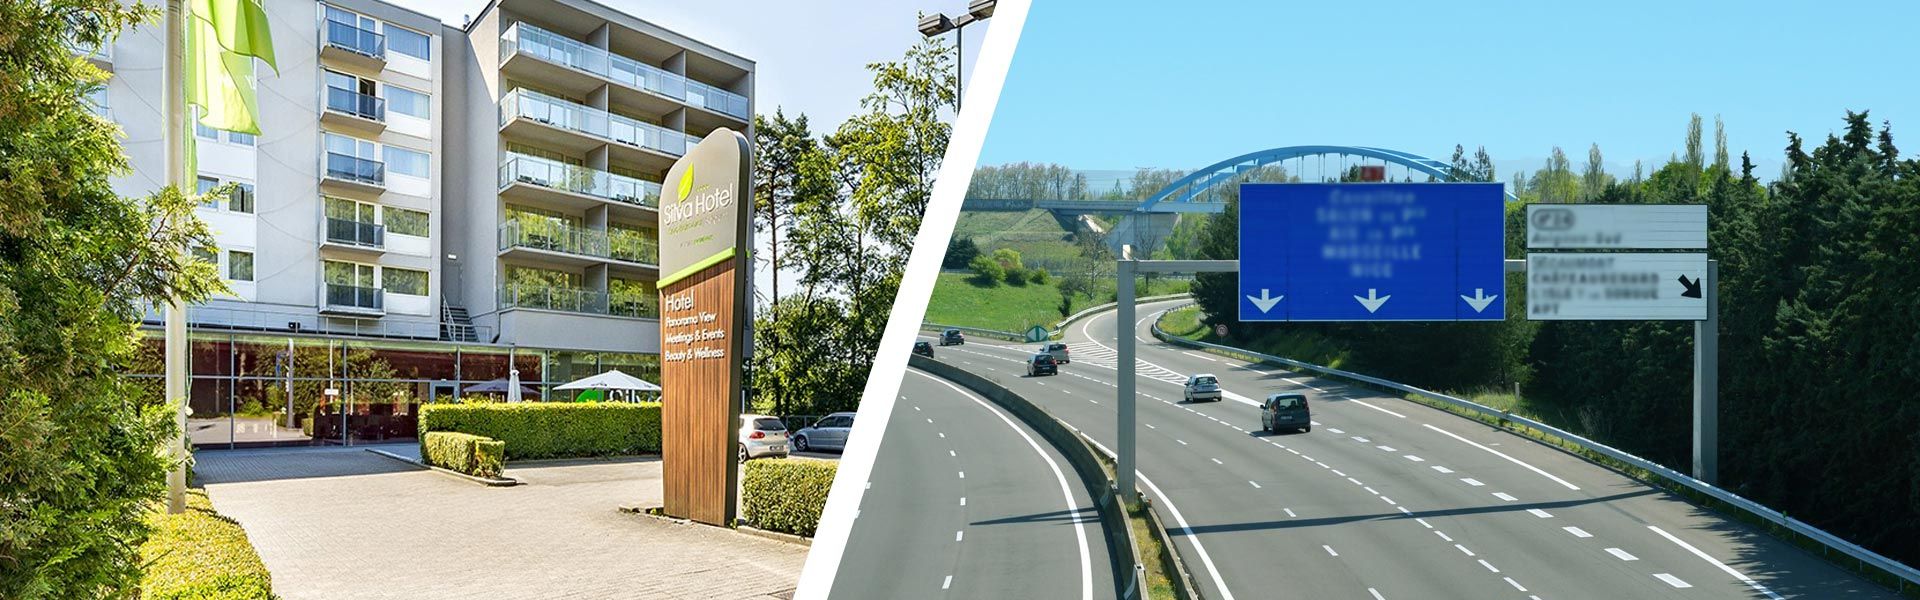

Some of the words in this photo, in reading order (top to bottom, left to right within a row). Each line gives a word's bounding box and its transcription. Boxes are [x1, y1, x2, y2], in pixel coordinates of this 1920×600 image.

[663, 202, 693, 225] Silva
[695, 182, 733, 215] Hotel
[665, 288, 695, 312] Hotel
[666, 316, 699, 328] Panorama
[698, 311, 718, 323] View
[665, 332, 694, 346] Meetings
[694, 329, 701, 342] &
[702, 328, 725, 341] Events
[665, 350, 686, 363] Beauty
[686, 348, 693, 360] &
[694, 346, 725, 360] Wellness
